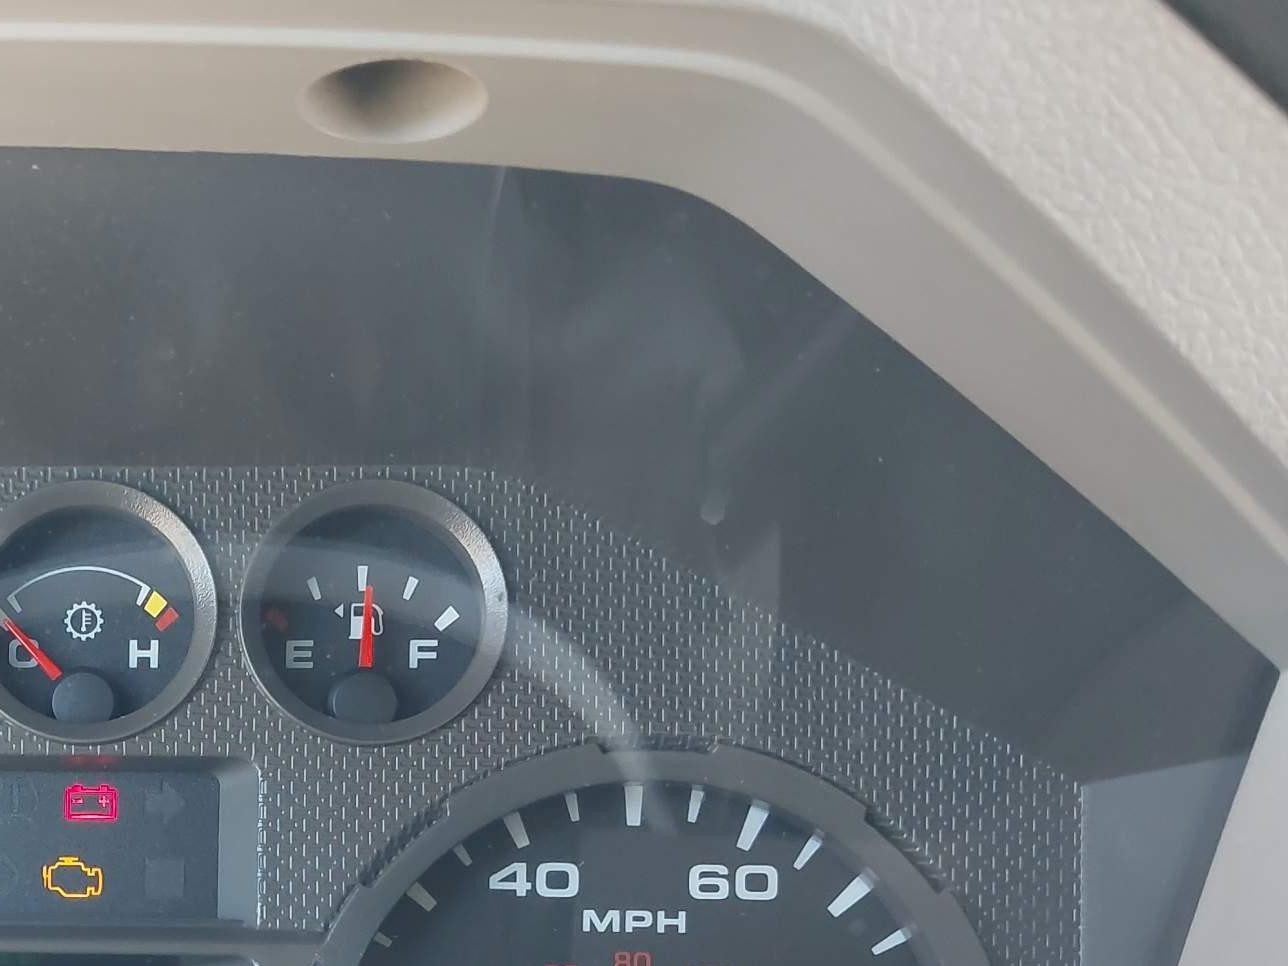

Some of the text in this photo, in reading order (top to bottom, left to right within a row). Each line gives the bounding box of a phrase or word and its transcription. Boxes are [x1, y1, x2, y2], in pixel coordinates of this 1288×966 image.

[129, 639, 159, 669] H
[285, 640, 314, 669] E
[409, 639, 439, 669] F
[488, 862, 580, 898] 40
[688, 864, 779, 901] 60
[582, 909, 687, 934] MPH
